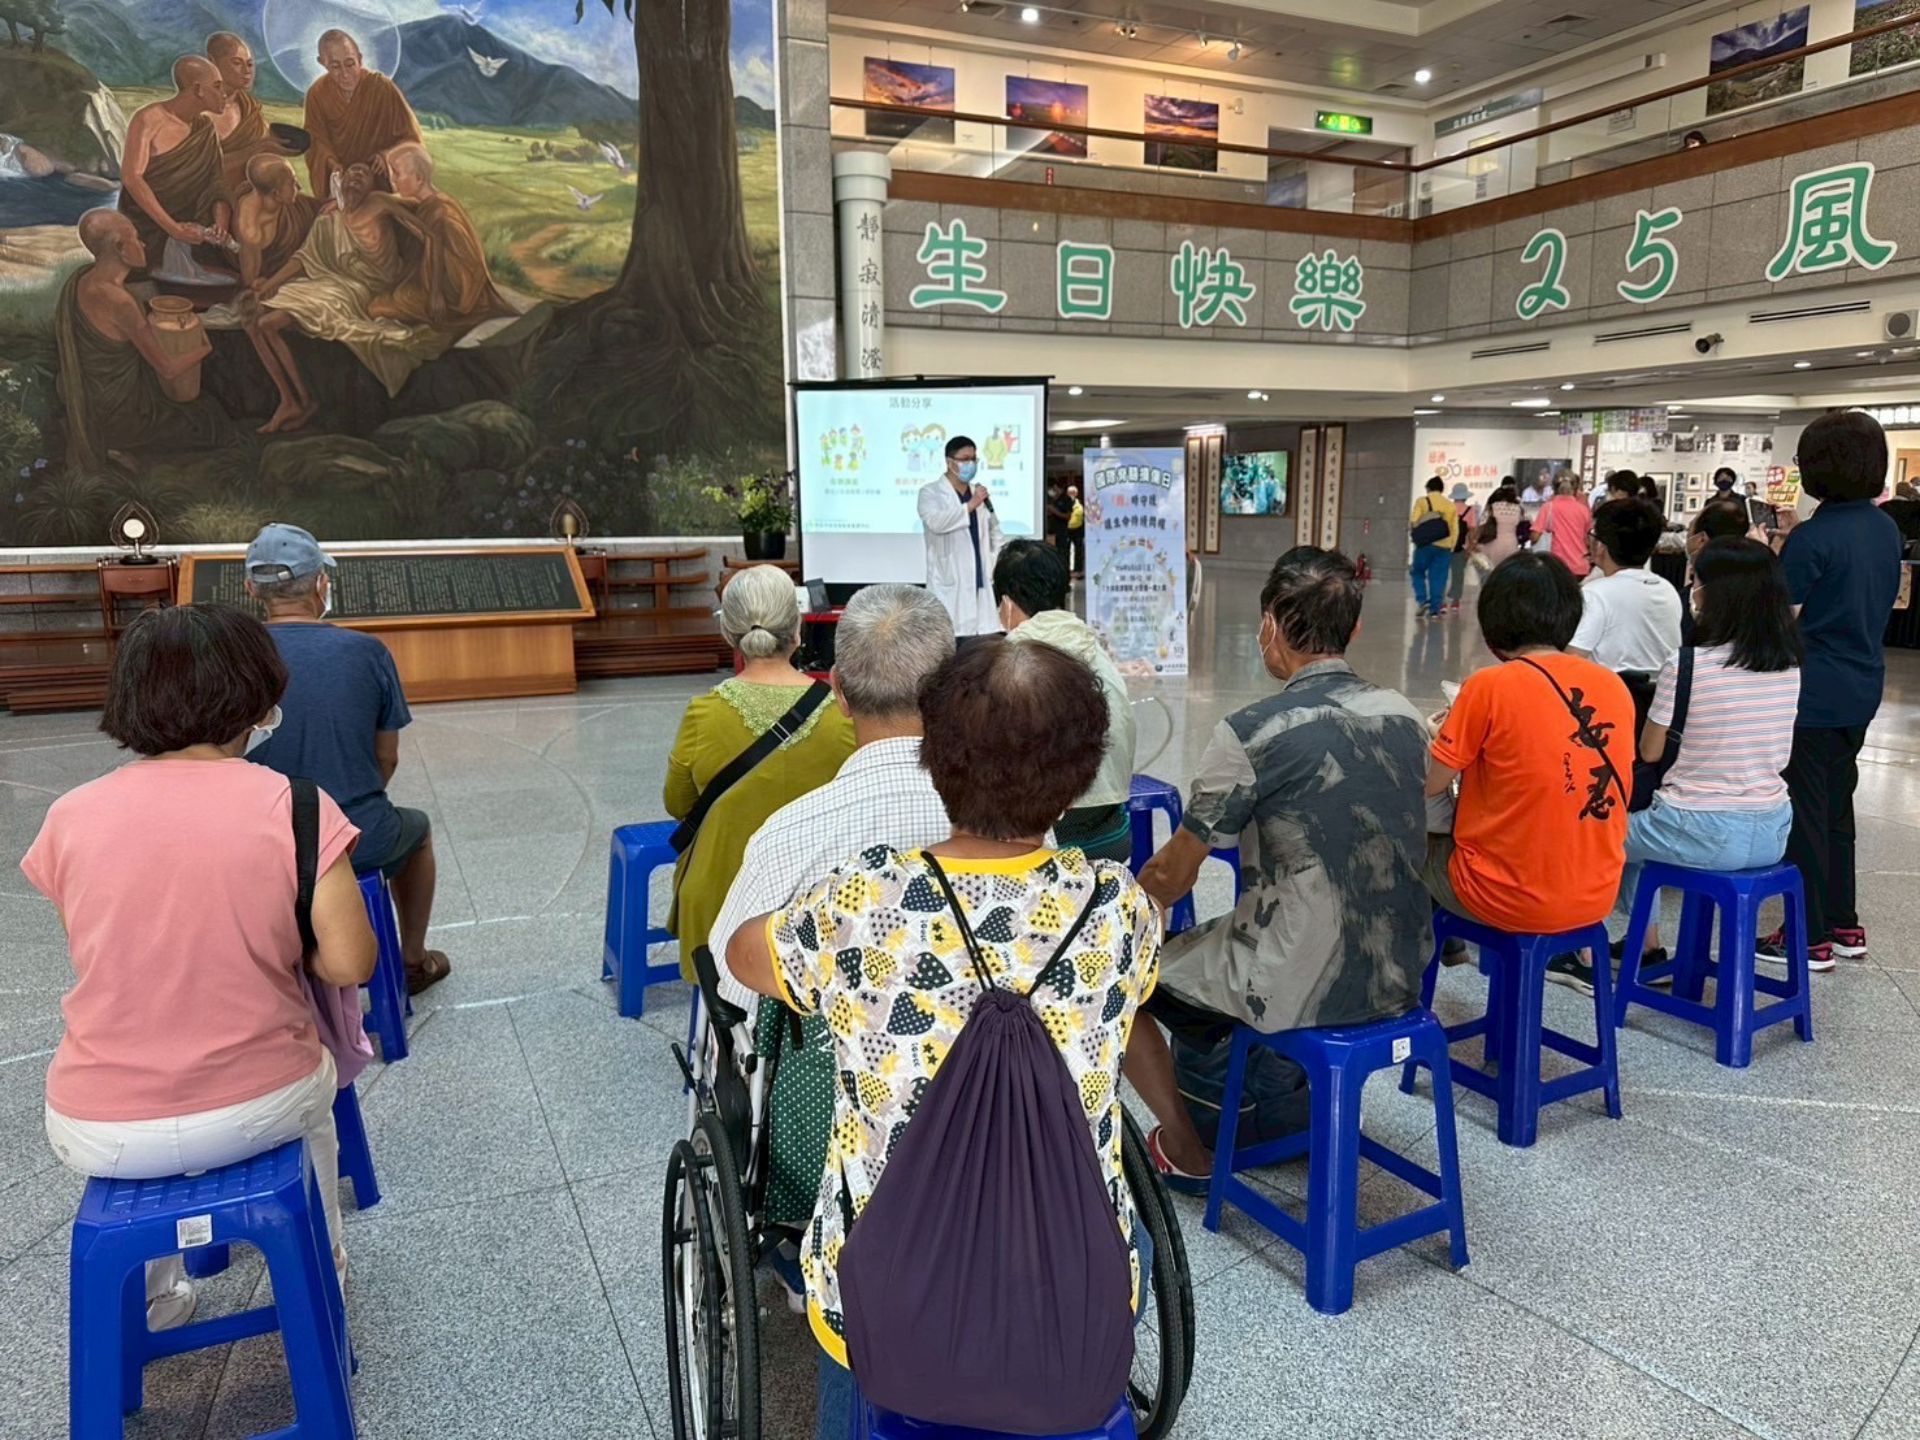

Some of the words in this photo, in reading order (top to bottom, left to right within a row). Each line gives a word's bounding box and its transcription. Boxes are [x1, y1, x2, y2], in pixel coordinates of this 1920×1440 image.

[856, 212, 883, 370] 靜寂清澄
[910, 217, 1366, 332] 生日快樂
[889, 396, 933, 409] 活動分享
